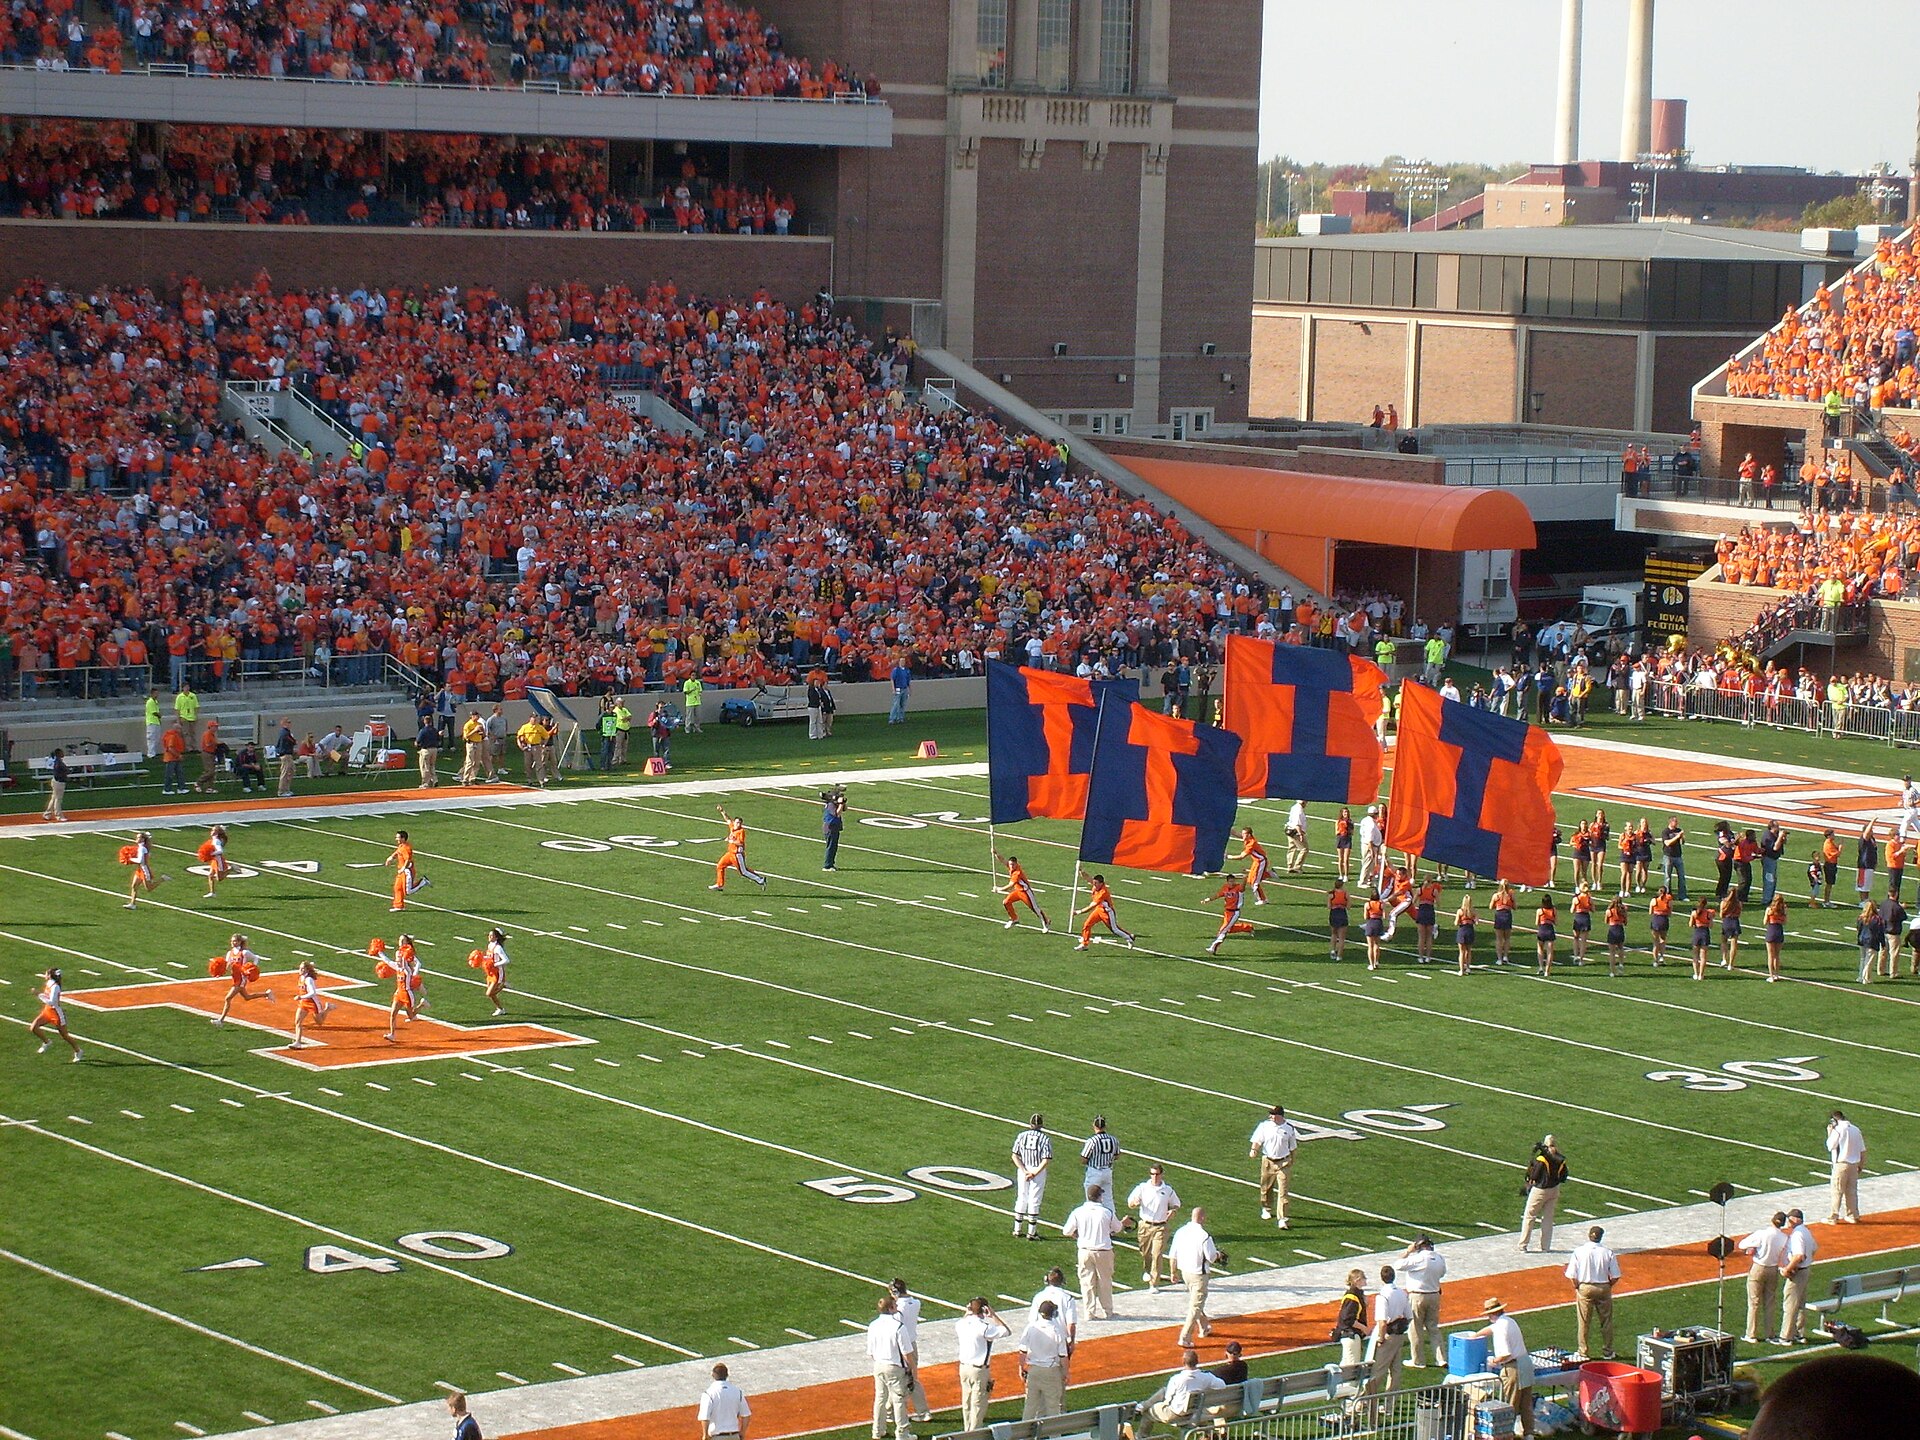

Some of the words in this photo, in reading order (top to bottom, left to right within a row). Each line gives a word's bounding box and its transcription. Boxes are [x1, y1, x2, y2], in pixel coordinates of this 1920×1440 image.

[624, 396, 636, 404] 130
[1659, 613, 1685, 623] IOWA
[951, 654, 957, 665] 6
[925, 744, 937, 756] 10
[651, 761, 664, 774] 20
[540, 834, 682, 853] 30
[1643, 1060, 1824, 1092] 30
[1101, 1138, 1112, 1153] U
[800, 1165, 1015, 1204] 50
[304, 1230, 515, 1273] 40
